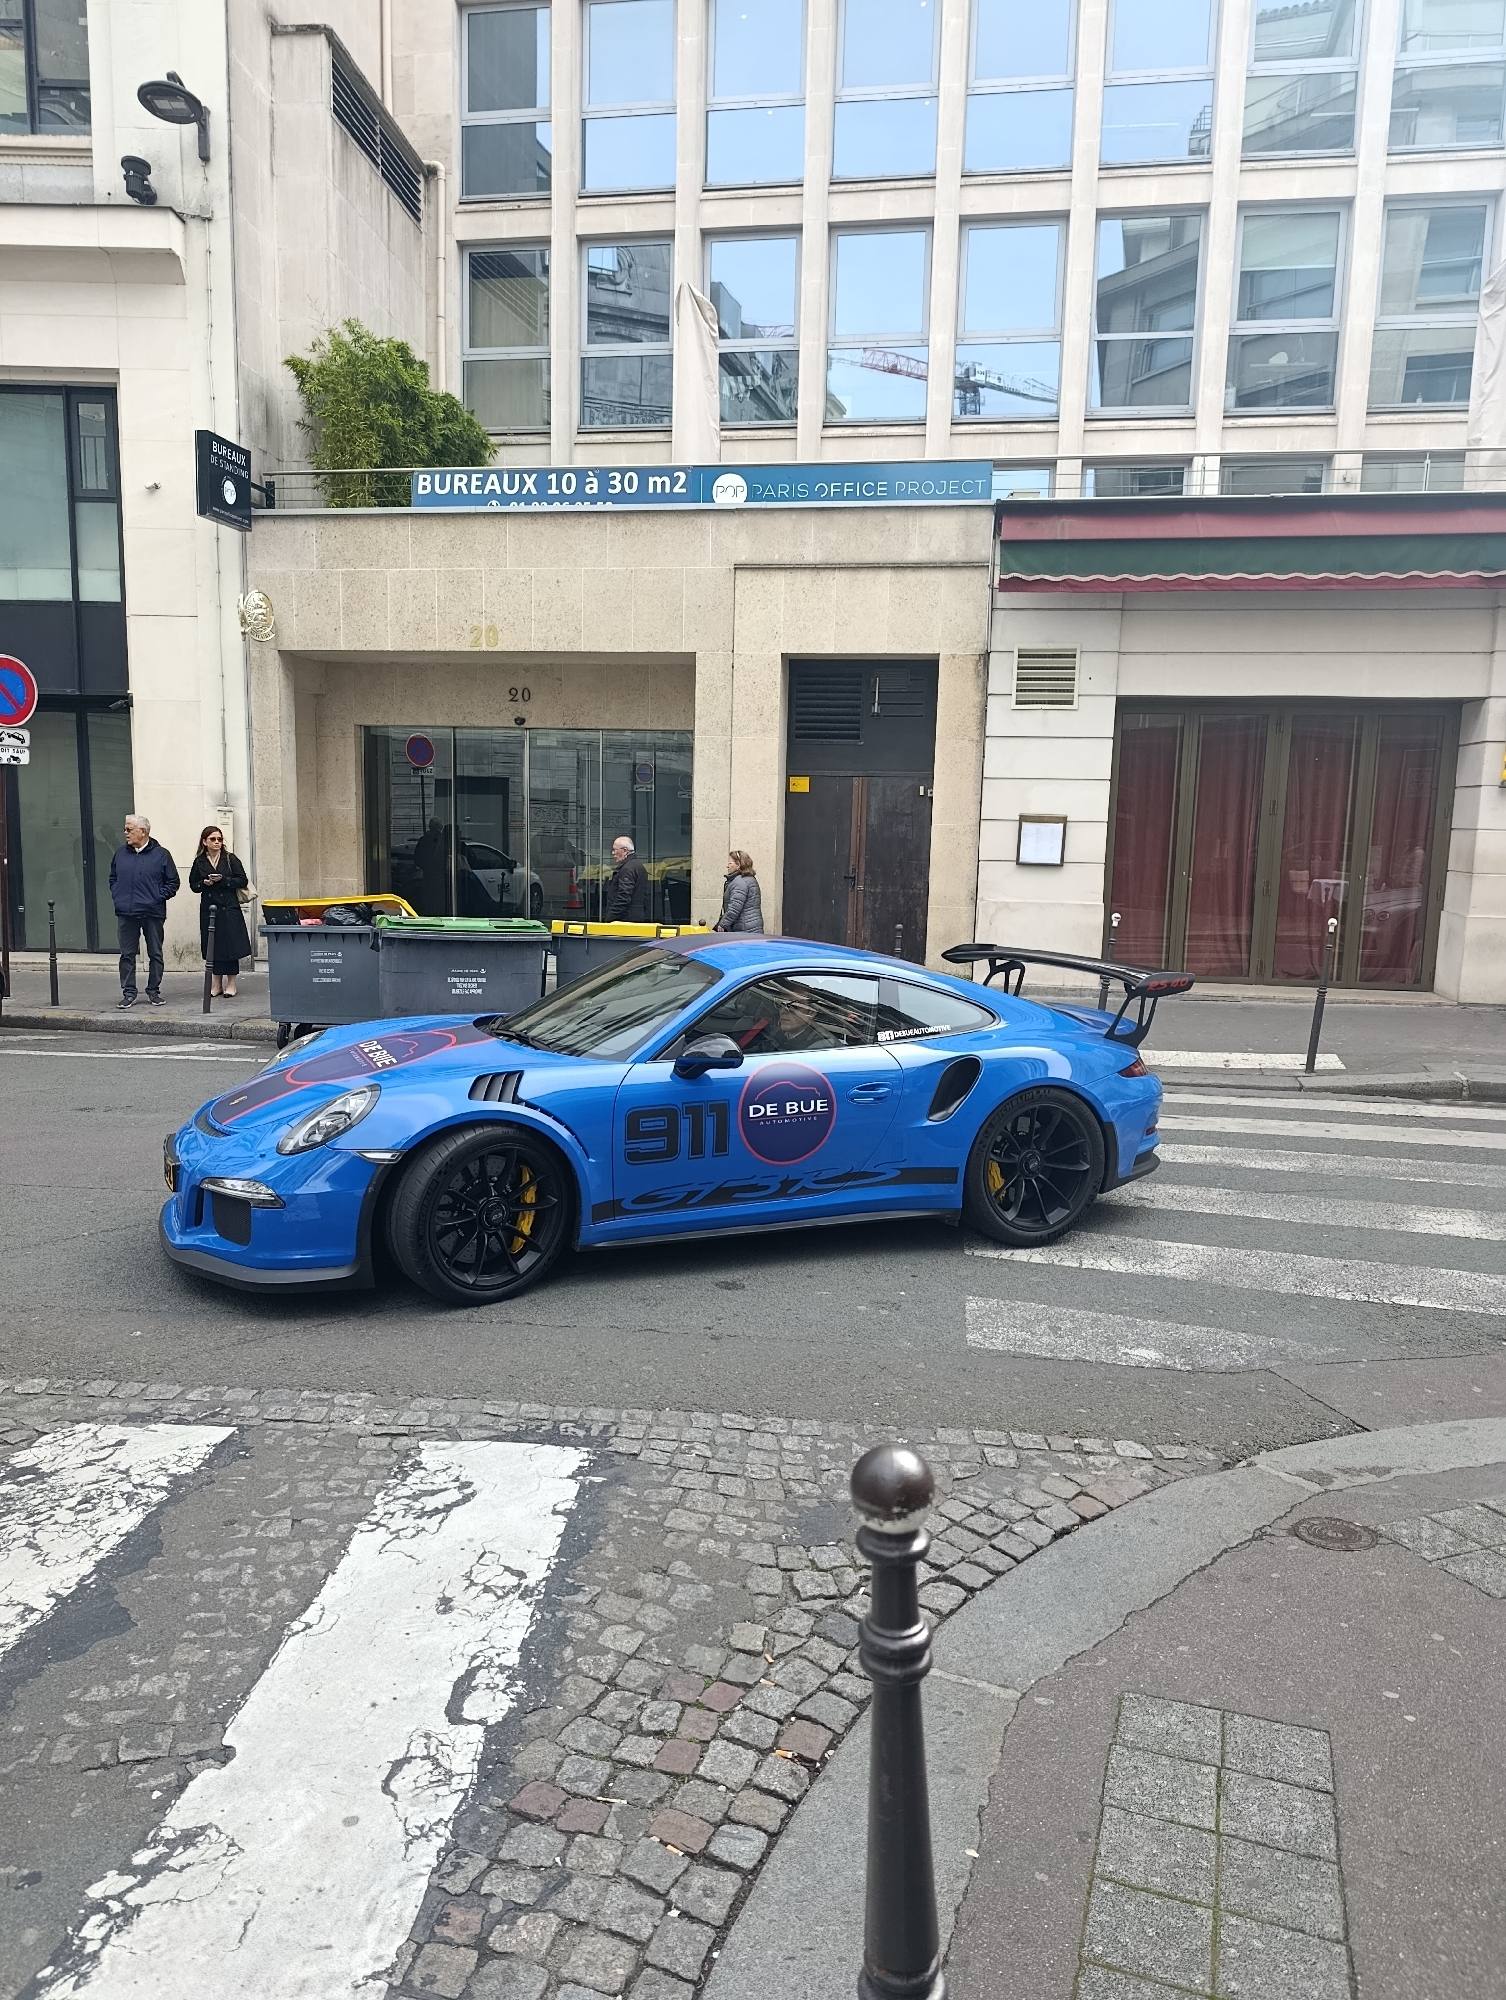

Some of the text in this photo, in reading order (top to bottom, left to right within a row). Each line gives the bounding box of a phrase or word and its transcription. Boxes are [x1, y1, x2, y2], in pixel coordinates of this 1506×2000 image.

[212, 440, 246, 467] BUREAUX
[210, 454, 249, 479] DE STANDING
[417, 470, 688, 495] BUREAUX 10 à 30 m2
[715, 485, 745, 499] POP
[752, 479, 987, 499] PARIS OFFICE PROJECT
[470, 625, 499, 648] 20
[508, 687, 531, 703] 20
[1147, 980, 1168, 991] RS
[358, 1040, 383, 1053] DE
[367, 1049, 398, 1068] BUE
[749, 1099, 829, 1118] DE BUE
[759, 1116, 818, 1125] AUTOMOTIVE
[624, 1099, 731, 1167] 911
